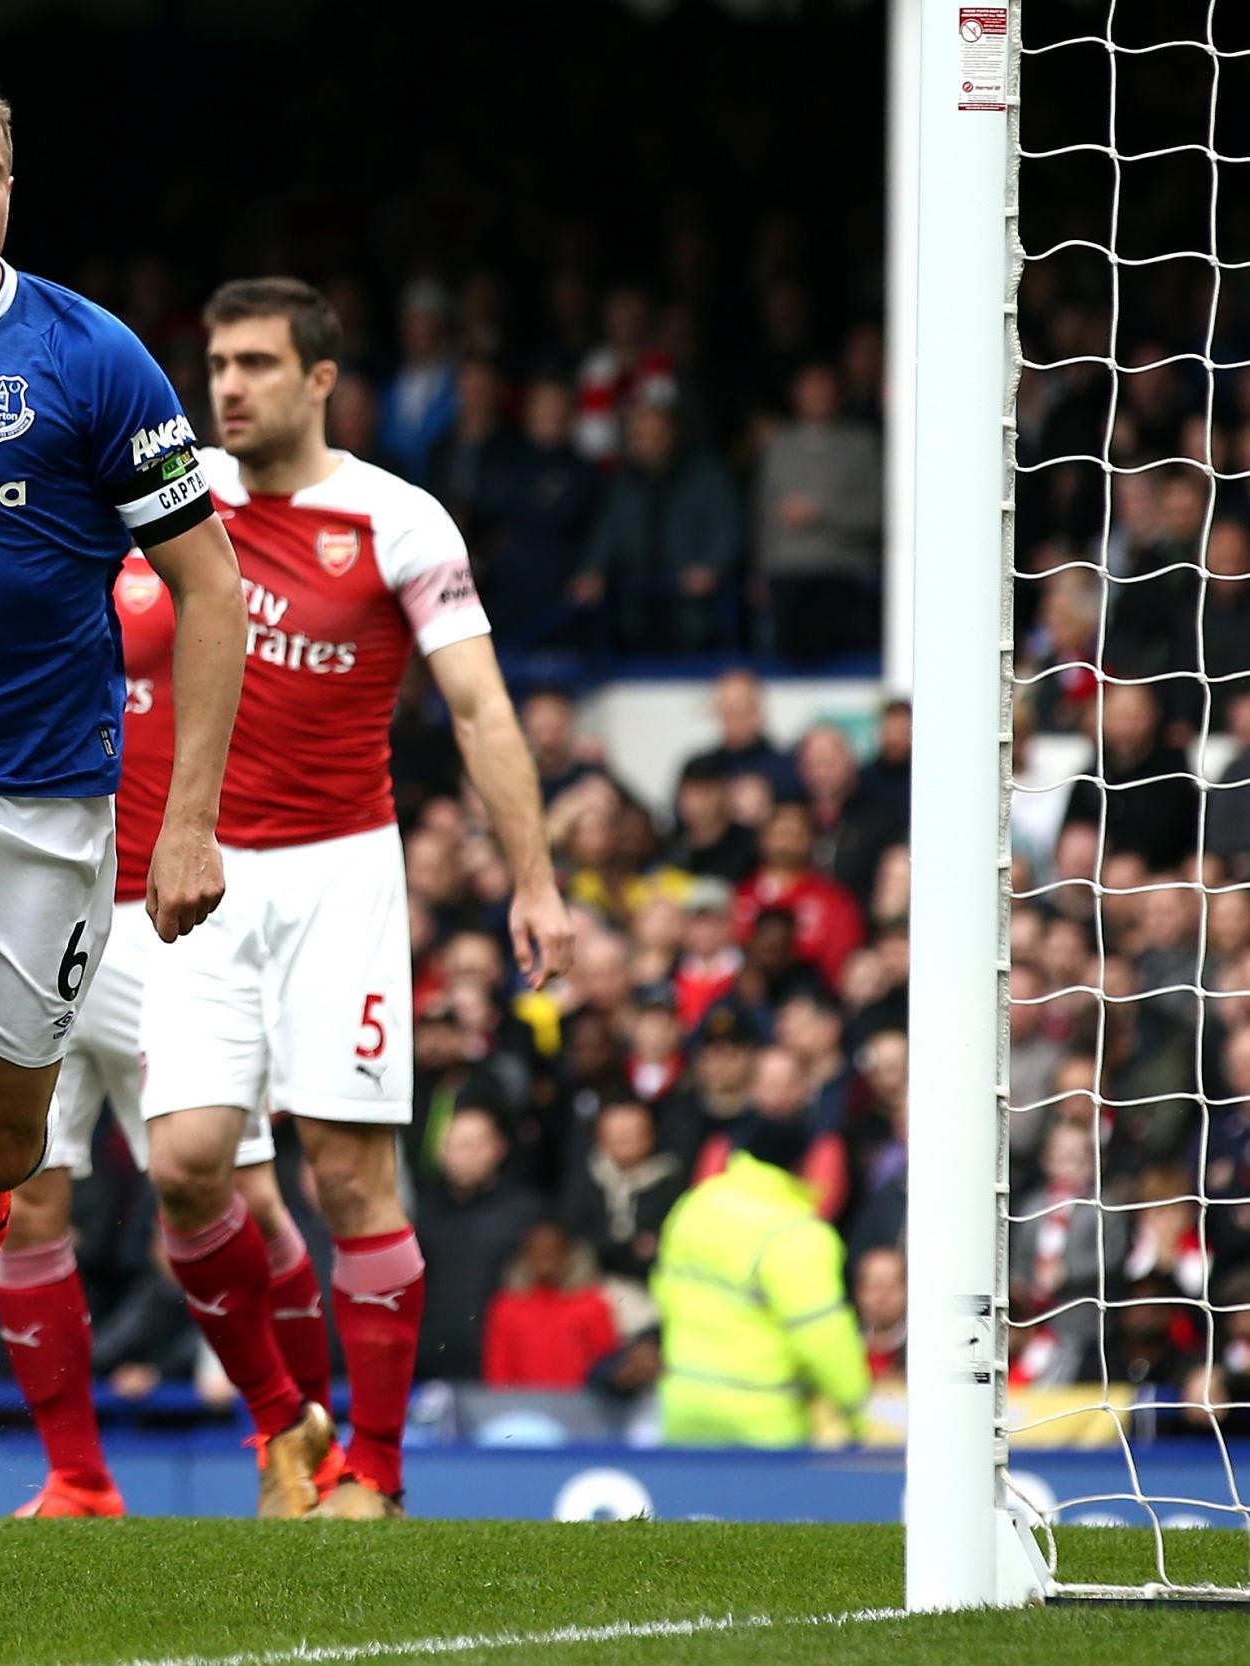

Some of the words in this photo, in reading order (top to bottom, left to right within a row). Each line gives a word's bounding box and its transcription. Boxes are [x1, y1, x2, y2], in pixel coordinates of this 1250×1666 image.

[245, 621, 357, 674] rates
[57, 919, 88, 1002] 6
[355, 993, 386, 1060] 5
